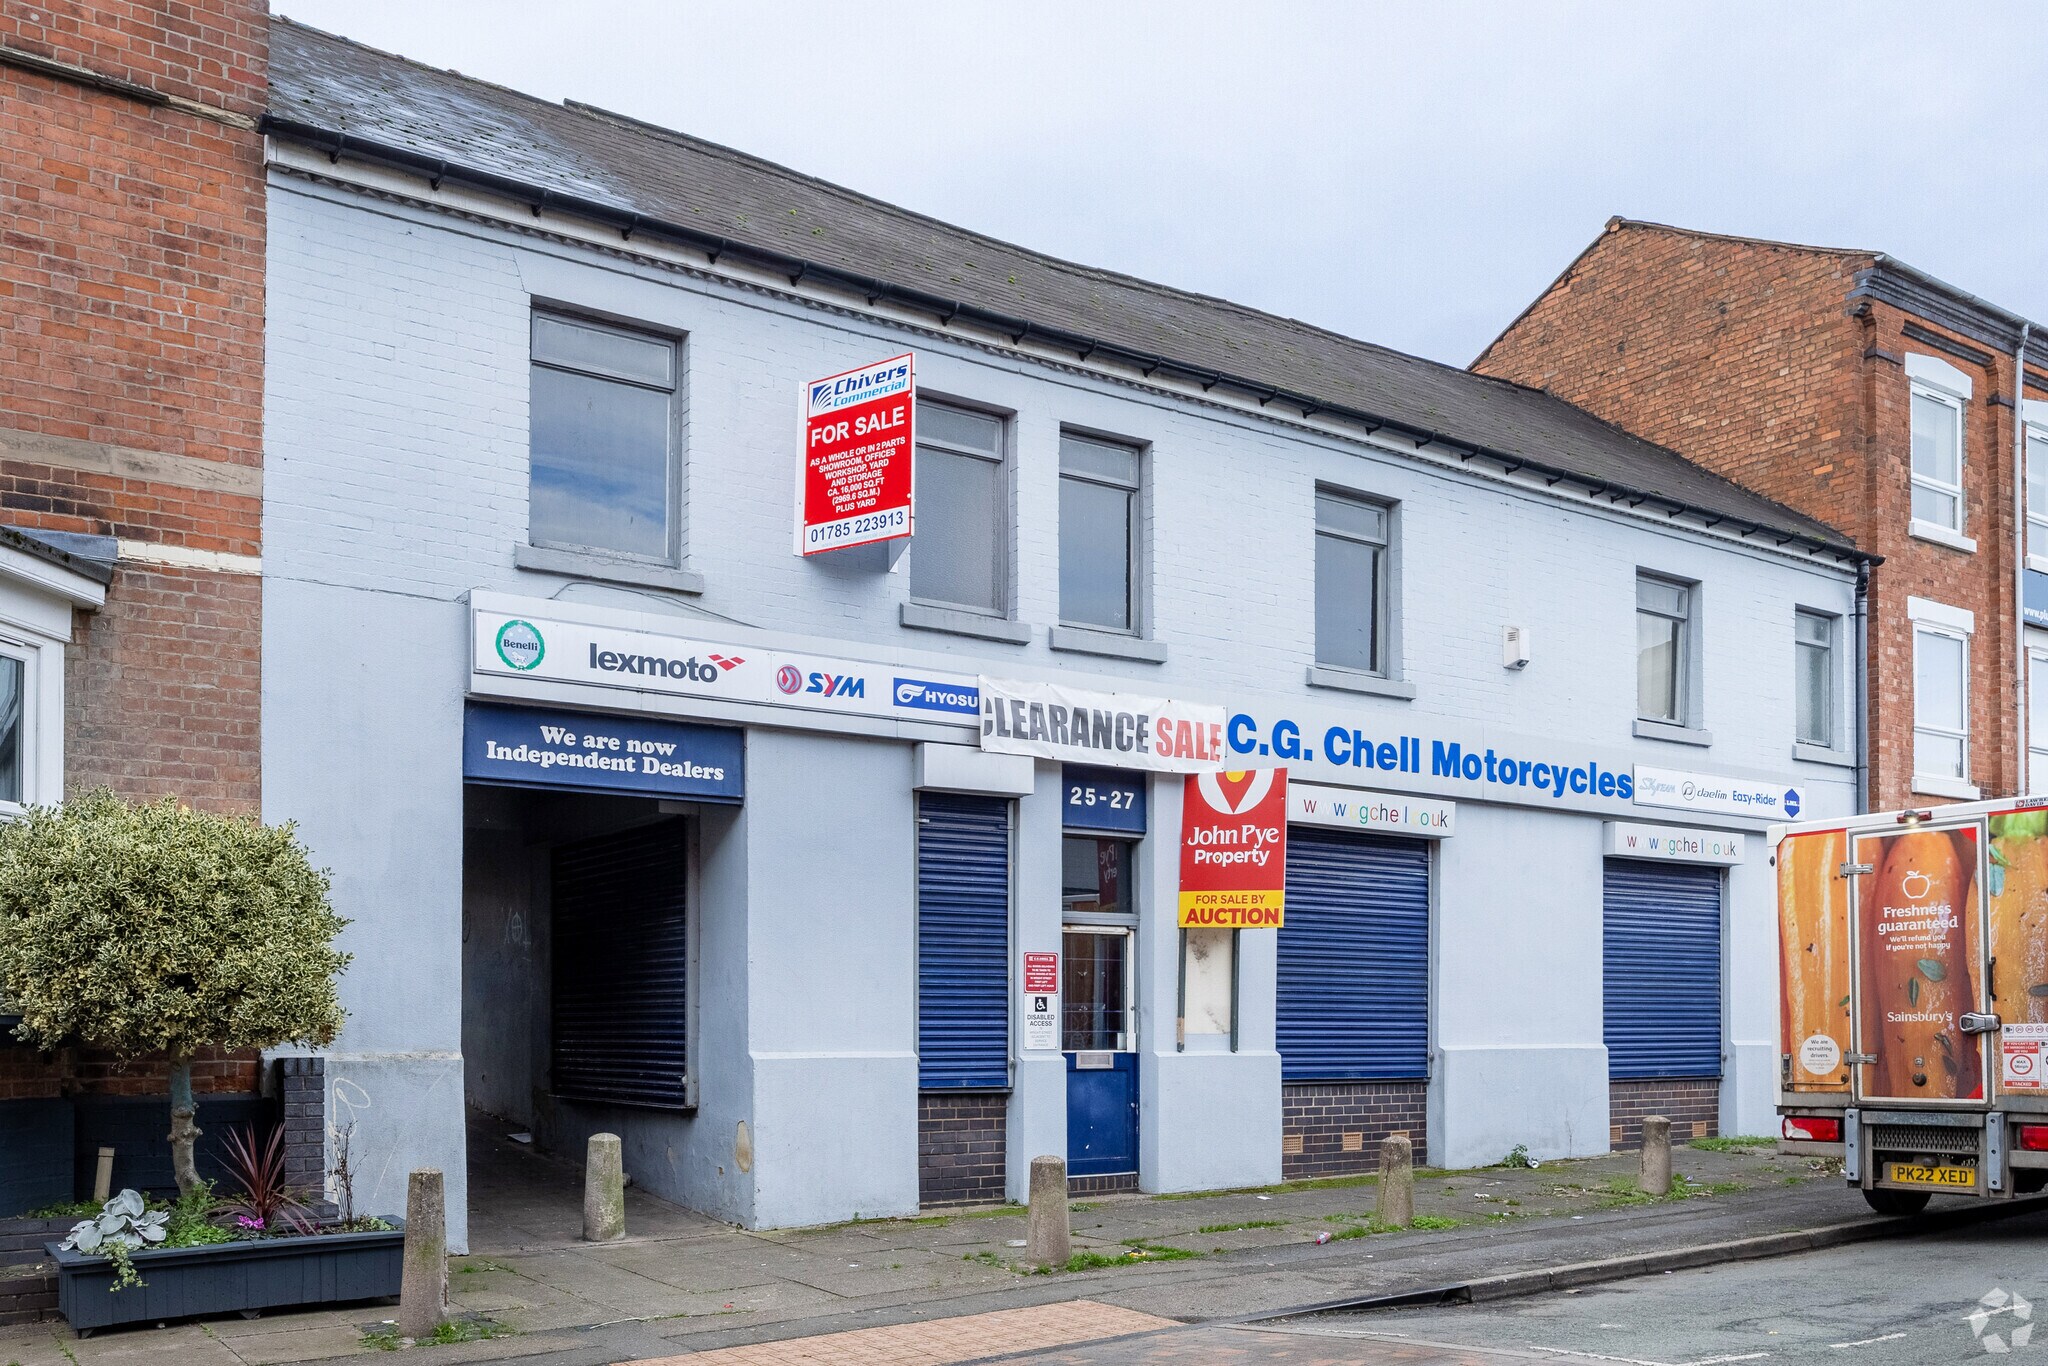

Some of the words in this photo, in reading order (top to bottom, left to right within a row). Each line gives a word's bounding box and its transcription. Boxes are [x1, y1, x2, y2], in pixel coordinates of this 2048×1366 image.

[834, 364, 908, 395] Chivers
[833, 378, 906, 407] Commercial
[811, 421, 850, 448] FOR
[854, 405, 905, 436] SALE
[810, 457, 820, 467] AS
[821, 456, 827, 464] A
[828, 450, 854, 463] WHOLE
[855, 446, 866, 455] OR
[867, 444, 875, 452] IN
[876, 442, 881, 450] 2
[881, 436, 906, 449] PARTS
[819, 457, 864, 473] SHOWROOM,
[865, 448, 896, 462] OFFICES
[825, 465, 868, 480] WORKSHOP,
[869, 458, 889, 470] YARD
[831, 477, 846, 488] AND
[848, 469, 883, 484] STORAGE
[827, 486, 840, 497] CA.
[840, 482, 862, 494] 16,000
[863, 477, 885, 489] SQ.FT
[857, 487, 880, 500] SQ.M.)
[836, 503, 855, 513] PLUS
[856, 498, 876, 508] YARD
[811, 522, 850, 543] 01785
[855, 511, 904, 534] 223913
[503, 639, 538, 651] Benelli
[589, 642, 718, 683] lexmoto
[805, 672, 865, 699] SYM
[925, 690, 978, 708] HYOSU
[540, 725, 576, 746] We
[583, 734, 621, 751] are
[627, 739, 677, 756] now
[1156, 716, 1222, 763] SALE
[486, 740, 636, 772] Independent
[642, 756, 724, 781] Dealers
[1227, 713, 1313, 762] C.G.
[1324, 726, 1420, 774] Chell
[1432, 740, 1633, 799] Motorcycles
[1697, 788, 1728, 800] daelim
[1187, 825, 1238, 846] John
[1242, 824, 1279, 849] Pye
[1194, 849, 1270, 867] Property
[1196, 895, 1217, 905] FOR
[1220, 894, 1248, 904] SALE
[1252, 894, 1266, 904] BY
[1184, 907, 1280, 925] AUCTION
[1883, 904, 1952, 918] Freshness
[1878, 915, 1959, 935] guaranteed
[1889, 935, 1907, 943] We'll
[1908, 934, 1931, 942] refund
[1932, 934, 1946, 943] you
[1892, 943, 1914, 952] you're
[1928, 941, 1951, 950] happy
[1887, 1010, 1953, 1024] Sainsbury's
[1897, 1167, 1934, 1182] PK22
[1938, 1169, 1968, 1183] XED
